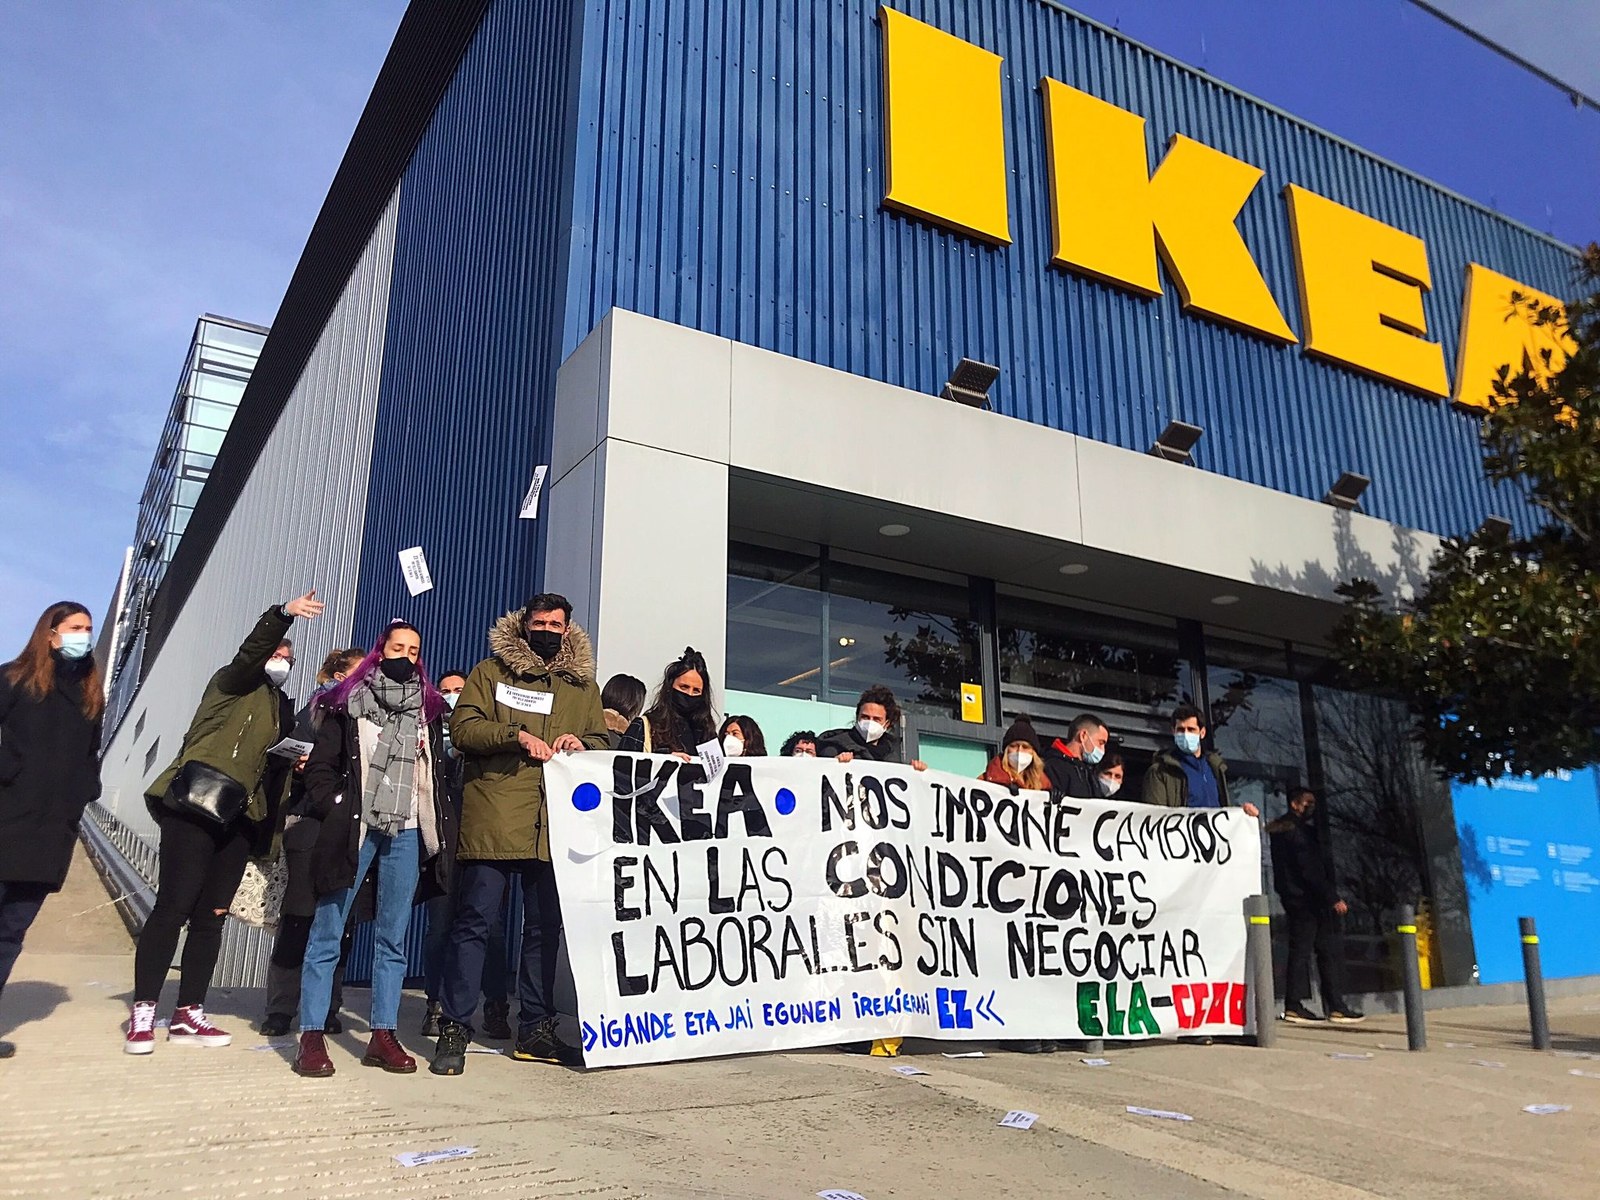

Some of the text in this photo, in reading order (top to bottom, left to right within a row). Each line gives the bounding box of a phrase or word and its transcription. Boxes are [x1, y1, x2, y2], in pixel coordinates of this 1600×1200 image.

[881, 5, 1580, 410] IKEA
[612, 755, 772, 846] IKEA
[821, 772, 911, 832] NOS
[931, 782, 1082, 858] IMPONE
[1093, 810, 1232, 865] CAMBIOS
[613, 840, 1157, 929] EN LAS CONDICIONES
[611, 909, 1208, 997] LABORALES SIN NEGOCIAR
[684, 1009, 721, 1036] ETA
[762, 996, 842, 1027] EGUNEN
